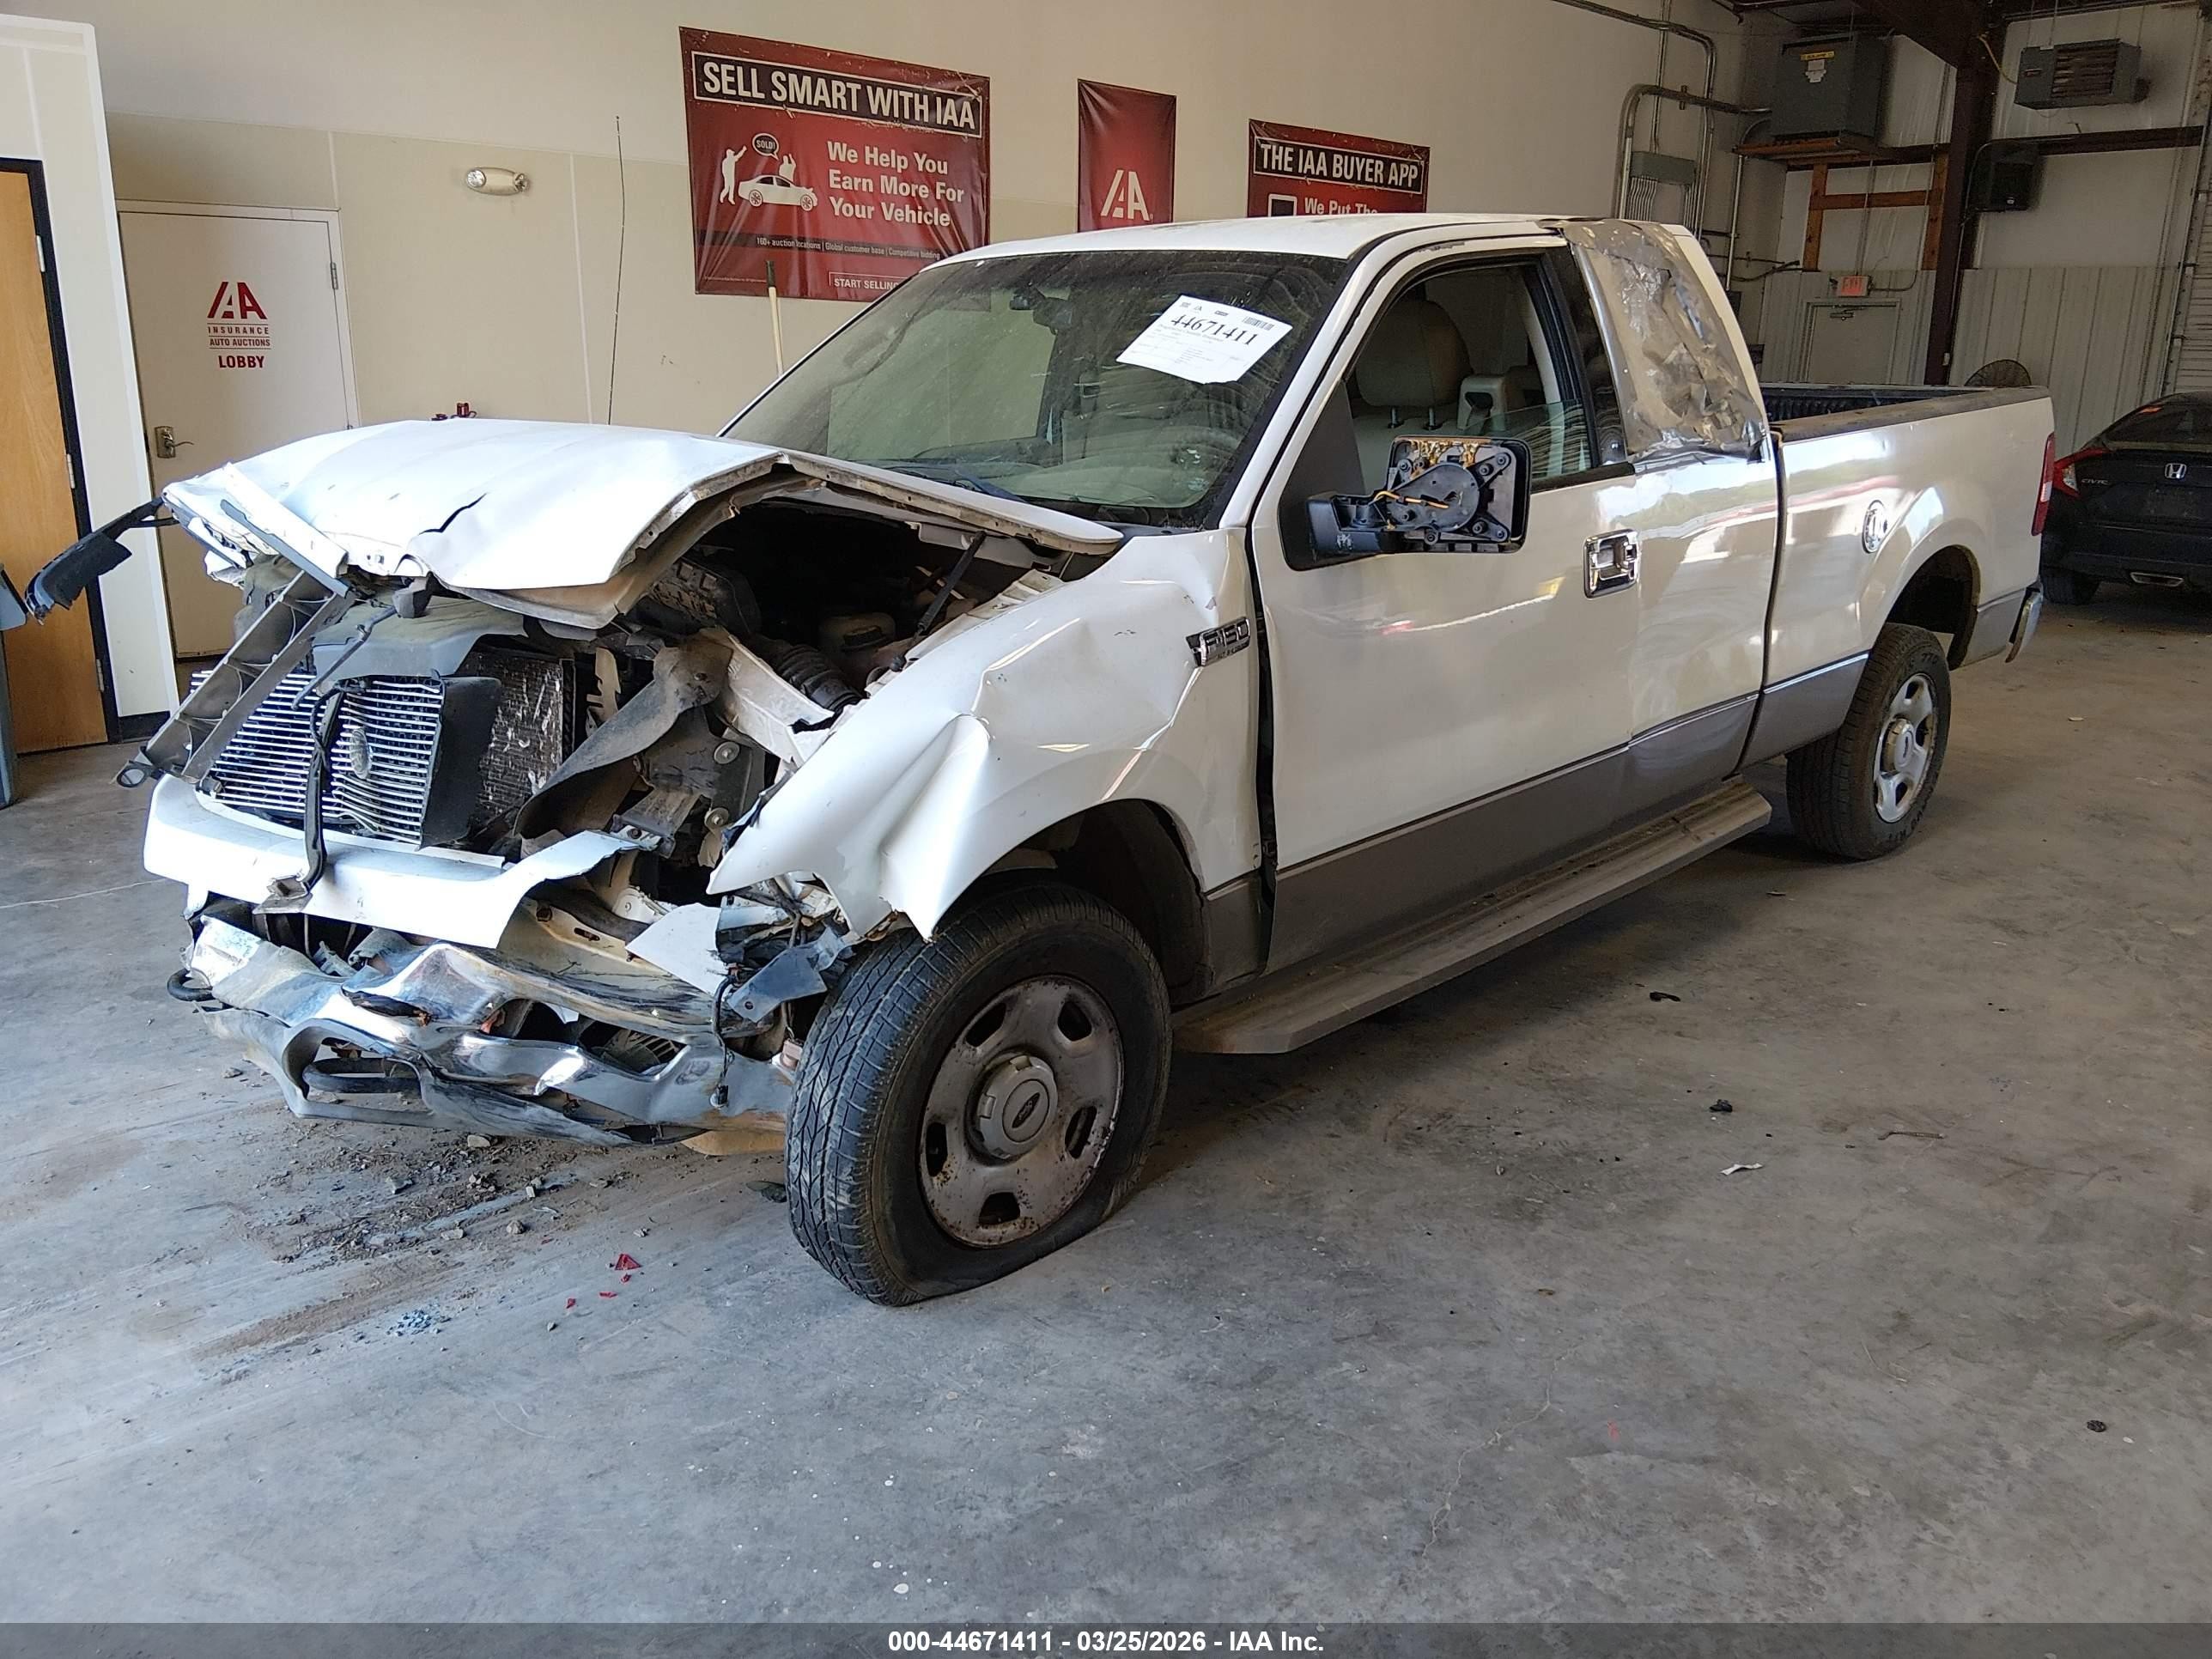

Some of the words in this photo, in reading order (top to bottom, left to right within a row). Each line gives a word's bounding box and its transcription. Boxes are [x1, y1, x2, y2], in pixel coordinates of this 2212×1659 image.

[703, 61, 765, 99] SELL
[771, 70, 861, 112] SMART
[866, 85, 929, 123] WITH
[936, 96, 975, 130] IAA
[827, 141, 858, 164] We
[864, 145, 908, 173] Help
[913, 151, 948, 175] You
[1260, 143, 1294, 172] THE
[1298, 148, 1328, 177] IAA
[1332, 153, 1384, 184] BUYER
[1388, 161, 1418, 188] APP
[829, 168, 874, 192] Earn
[880, 174, 929, 198] More
[935, 181, 965, 203] For
[829, 196, 875, 219] Your
[881, 202, 951, 228] Vehicle
[1304, 197, 1325, 215] We
[1328, 199, 1352, 215] Put
[771, 238, 795, 247] auction
[795, 239, 821, 249] locations
[824, 241, 843, 252] Global
[844, 245, 870, 253] customer
[871, 246, 884, 255] base
[920, 250, 940, 260] bidding
[834, 277, 862, 289] START
[208, 326, 269, 335] INSURANCE
[232, 338, 270, 347] AUCTIONS
[1170, 314, 1258, 345] 44671411
[218, 355, 264, 368] LOBBY
